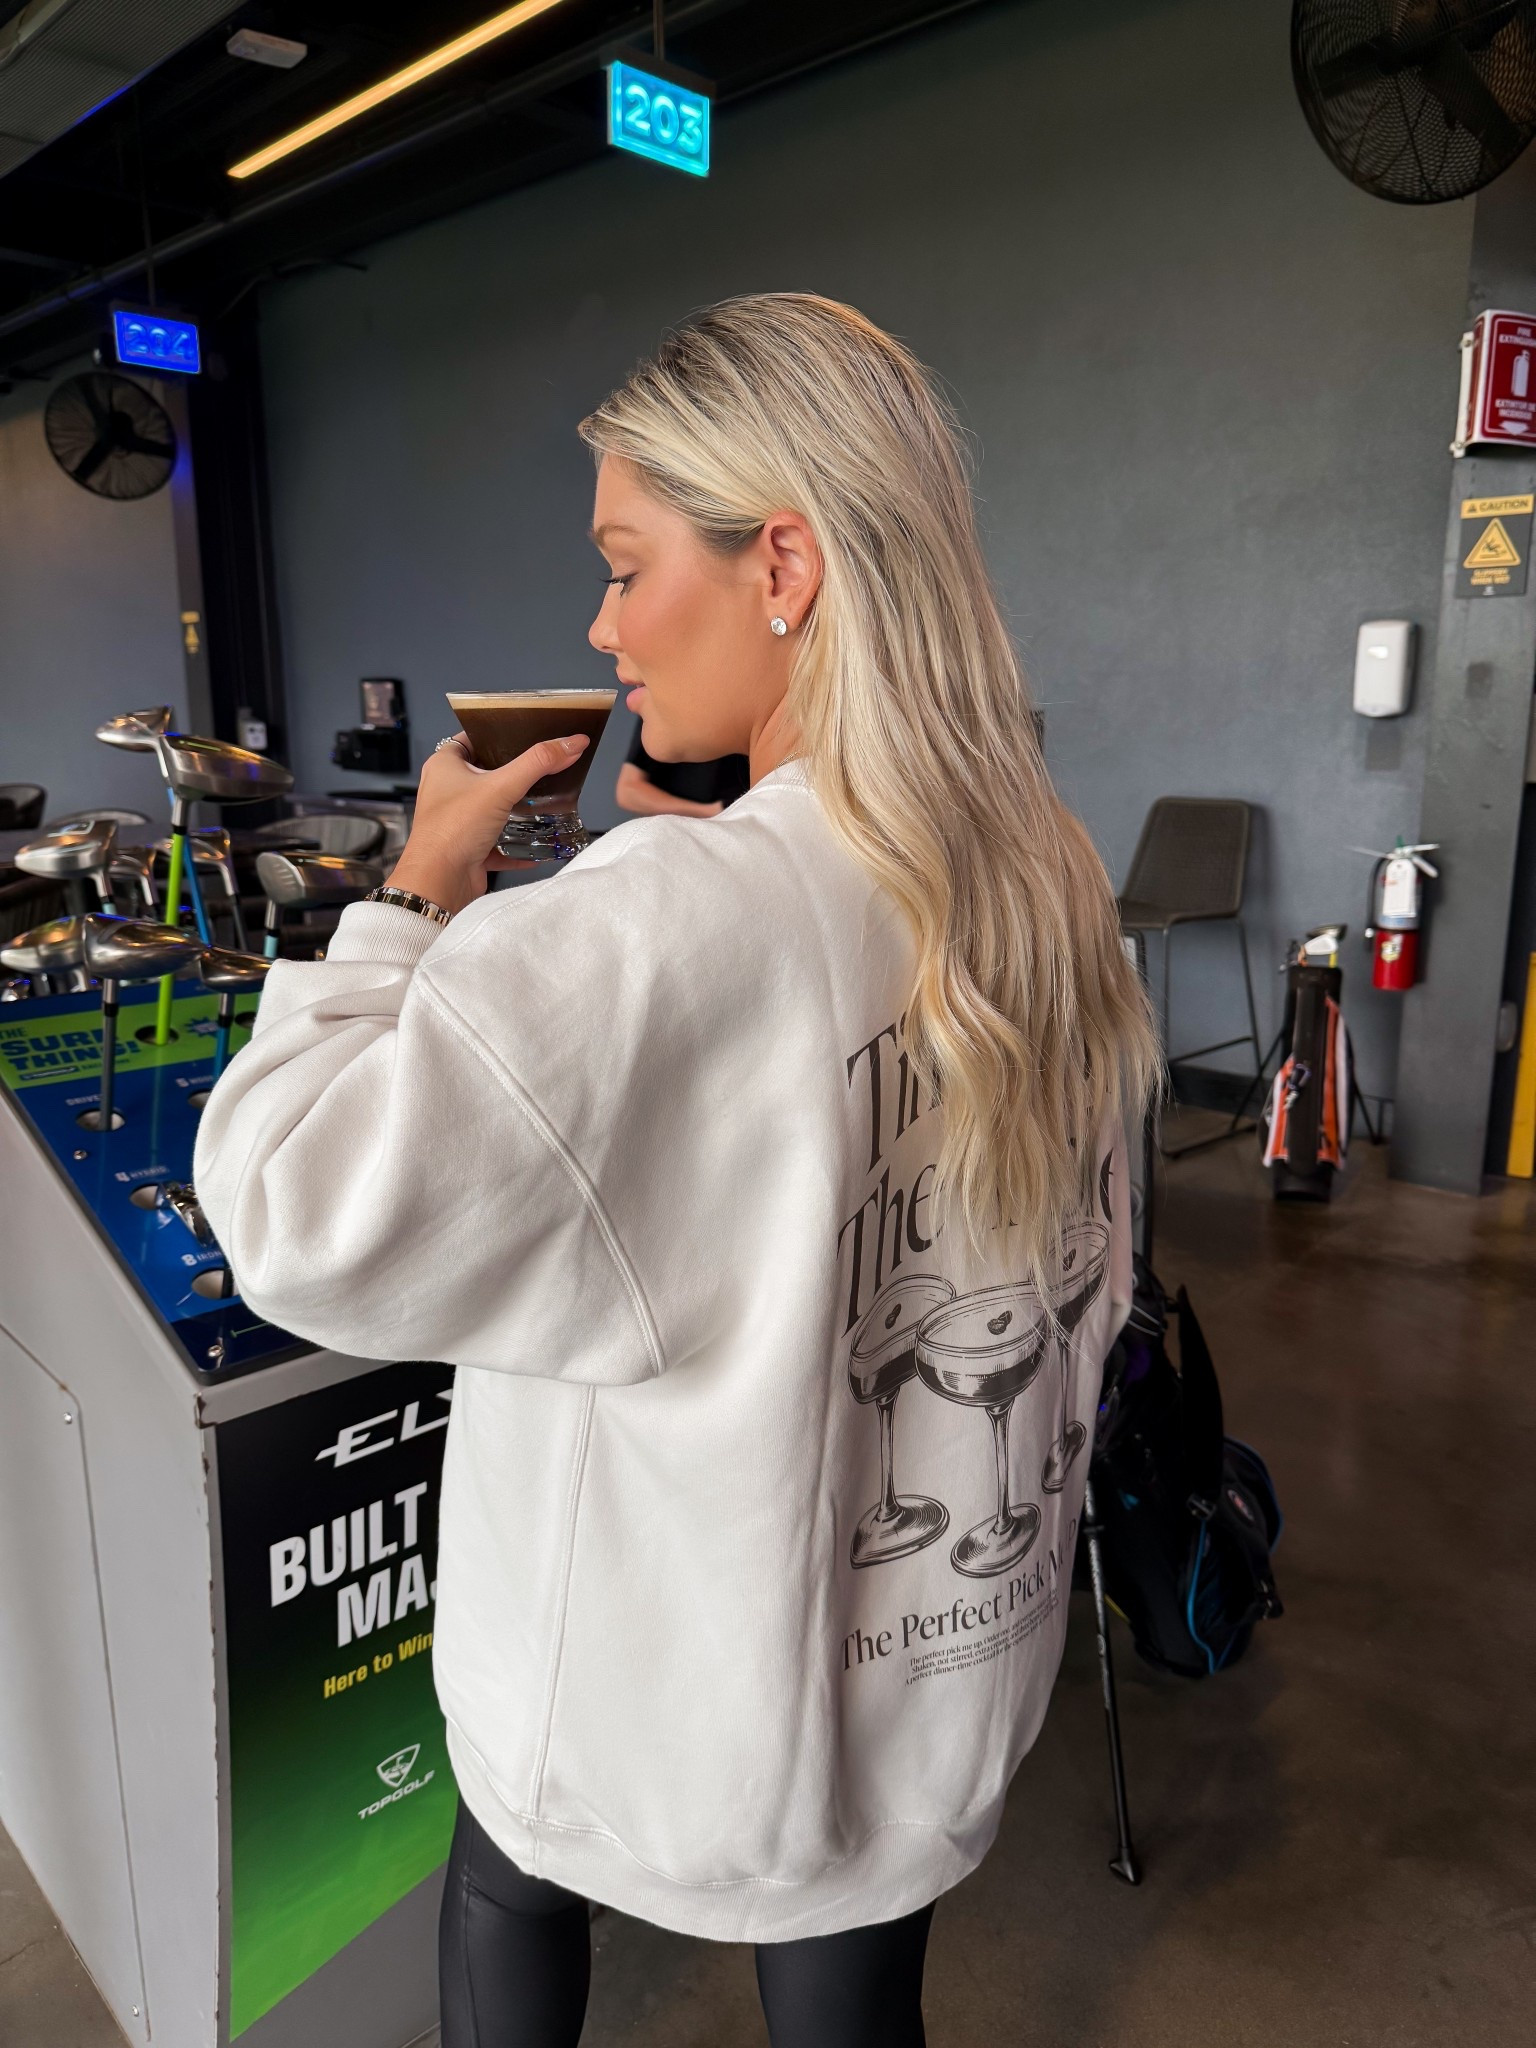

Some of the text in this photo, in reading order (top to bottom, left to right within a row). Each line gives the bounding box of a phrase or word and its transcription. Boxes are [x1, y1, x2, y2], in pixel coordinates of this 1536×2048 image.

[625, 84, 703, 154] 203
[126, 323, 196, 361] 204
[1479, 500, 1528, 512] CAUTION
[314, 1388, 453, 1468] EL
[269, 1481, 428, 1608] BUILT
[337, 1553, 437, 1648] MA
[840, 1628, 893, 1671] The
[901, 1590, 1002, 1649] Perfect
[1008, 1560, 1044, 1611] Pick
[324, 1665, 368, 1698] Here
[373, 1652, 393, 1674] to
[910, 1671, 932, 1685] perfect
[922, 1649, 945, 1666] perfect
[946, 1645, 961, 1657] pick
[962, 1643, 973, 1652] me
[937, 1656, 949, 1665] not
[357, 1769, 435, 1820] TOPGOLF
